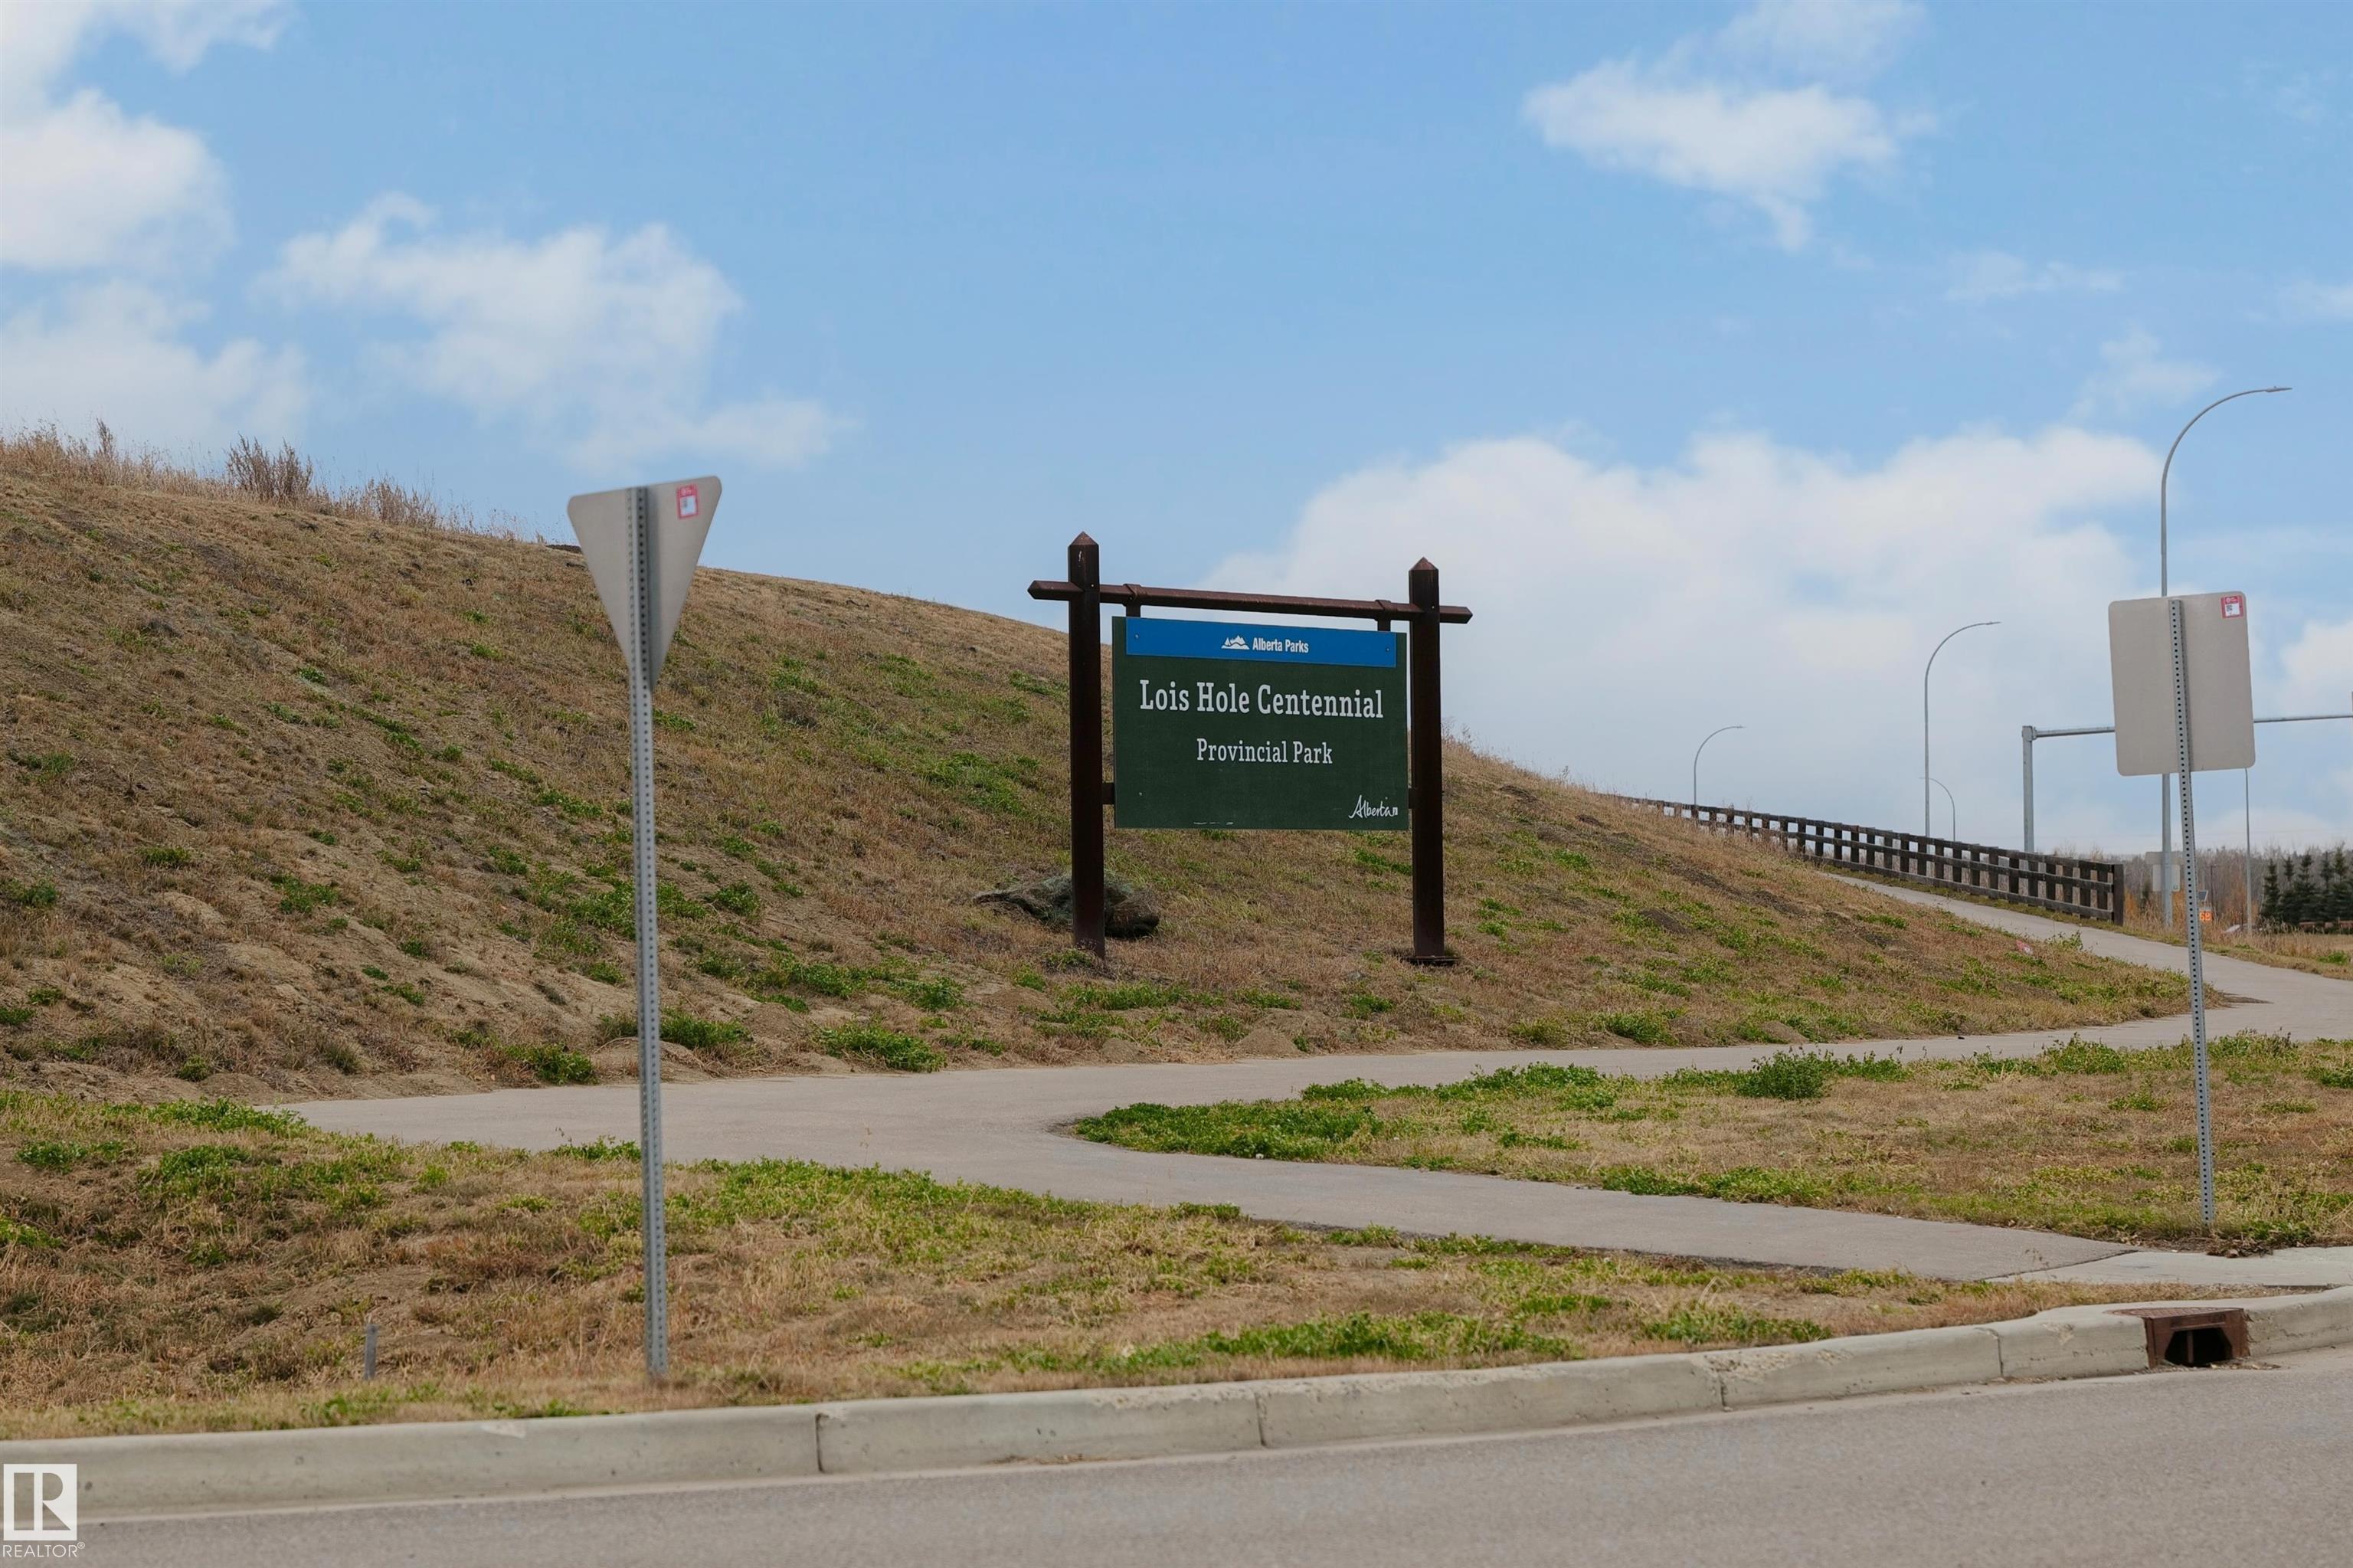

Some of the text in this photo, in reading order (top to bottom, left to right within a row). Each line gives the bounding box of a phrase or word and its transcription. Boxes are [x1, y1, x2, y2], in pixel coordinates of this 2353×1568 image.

[1252, 637, 1309, 653] Alberta Parks
[1140, 679, 1384, 719] Lois Hole Centennial
[1196, 738, 1334, 764] Provincial Park
[1348, 794, 1395, 819] Alberta
